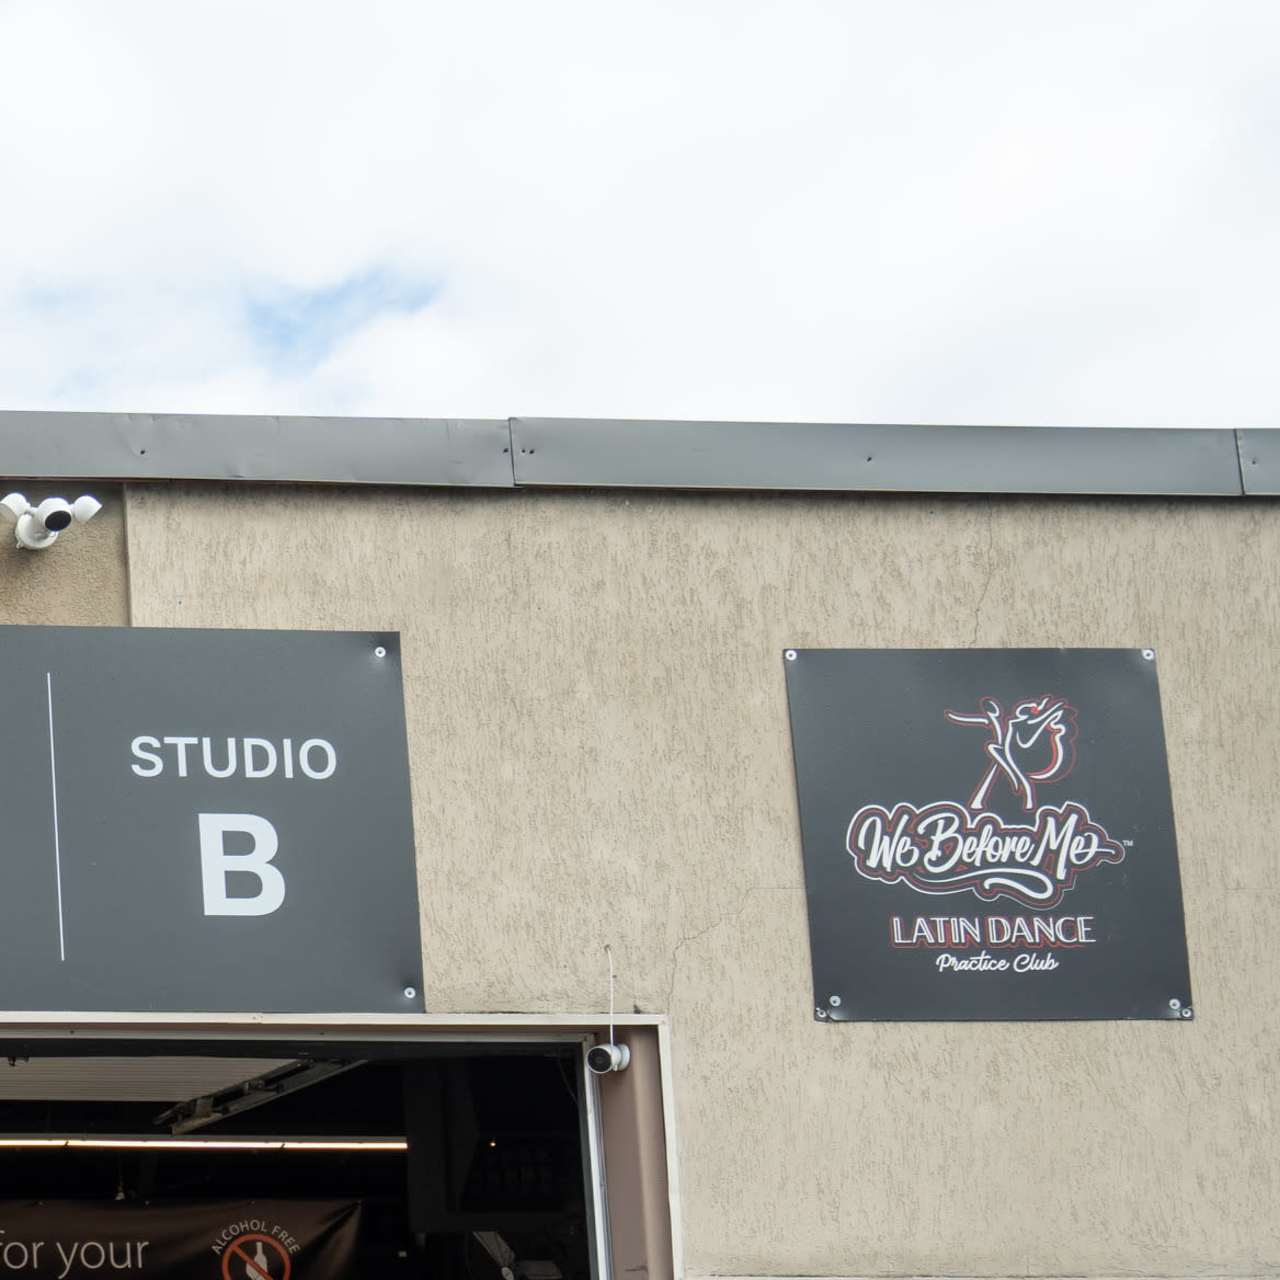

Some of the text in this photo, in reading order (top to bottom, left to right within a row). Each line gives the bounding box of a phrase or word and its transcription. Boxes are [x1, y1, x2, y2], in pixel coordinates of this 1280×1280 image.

[128, 735, 338, 780] STUDIO
[197, 812, 287, 917] B
[858, 813, 919, 869] We
[917, 811, 1036, 873] Before
[1030, 813, 1116, 880] Me
[891, 915, 1097, 944] LATIN DANCE
[935, 949, 1060, 973] Practice Club
[210, 1219, 301, 1254] ALCOHOL FREE
[55, 1239, 150, 1280] your
